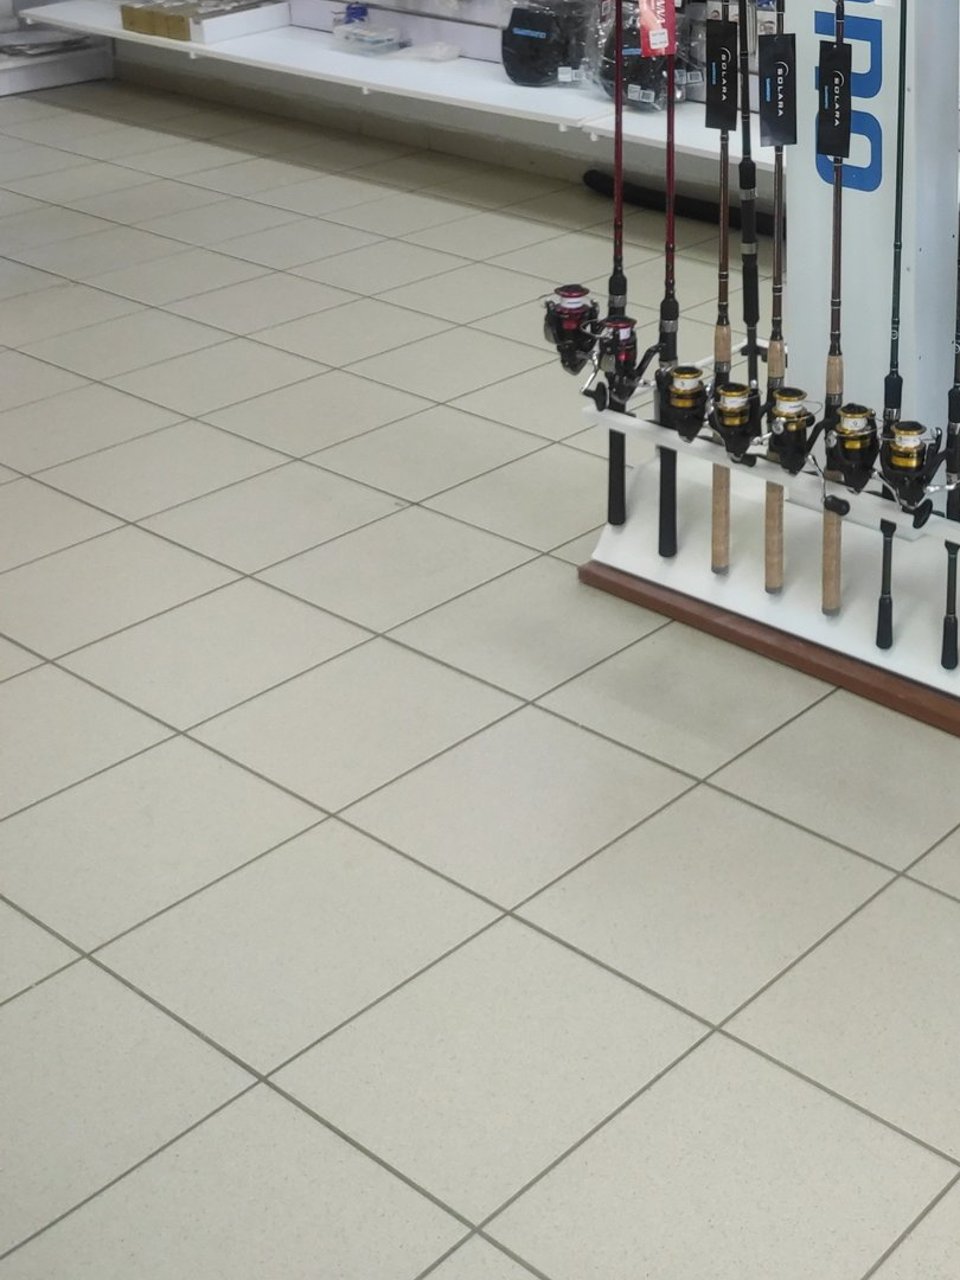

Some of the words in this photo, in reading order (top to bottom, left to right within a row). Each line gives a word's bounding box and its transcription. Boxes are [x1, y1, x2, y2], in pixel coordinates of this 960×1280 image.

[720, 52, 728, 102] SOLARA
[776, 67, 785, 118] SOLARA
[832, 75, 842, 127] SOLARA
